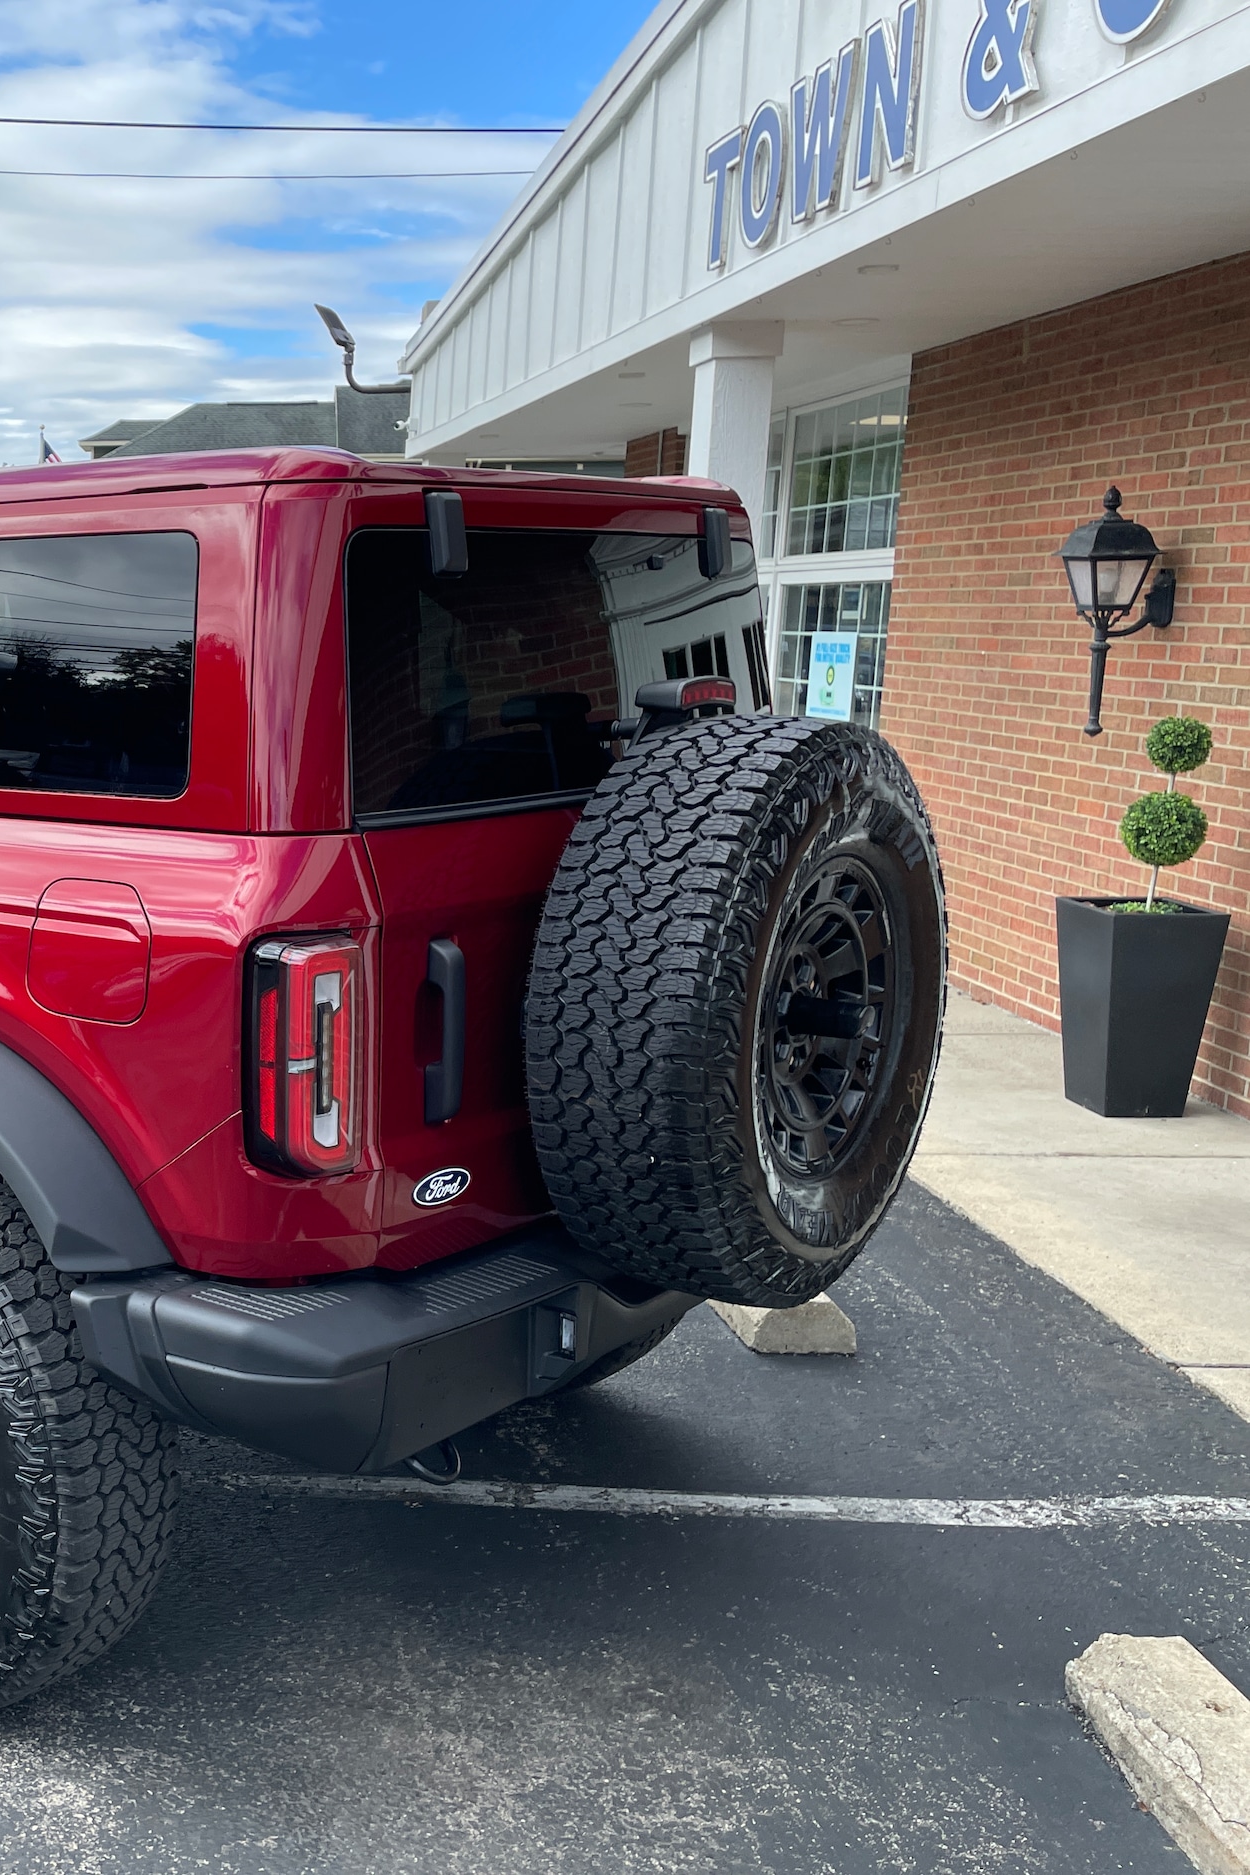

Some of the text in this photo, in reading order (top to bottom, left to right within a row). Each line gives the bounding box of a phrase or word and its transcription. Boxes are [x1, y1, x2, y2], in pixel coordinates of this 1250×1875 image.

[703, 0, 1039, 271] TOWN &
[424, 1173, 463, 1202] Ford
